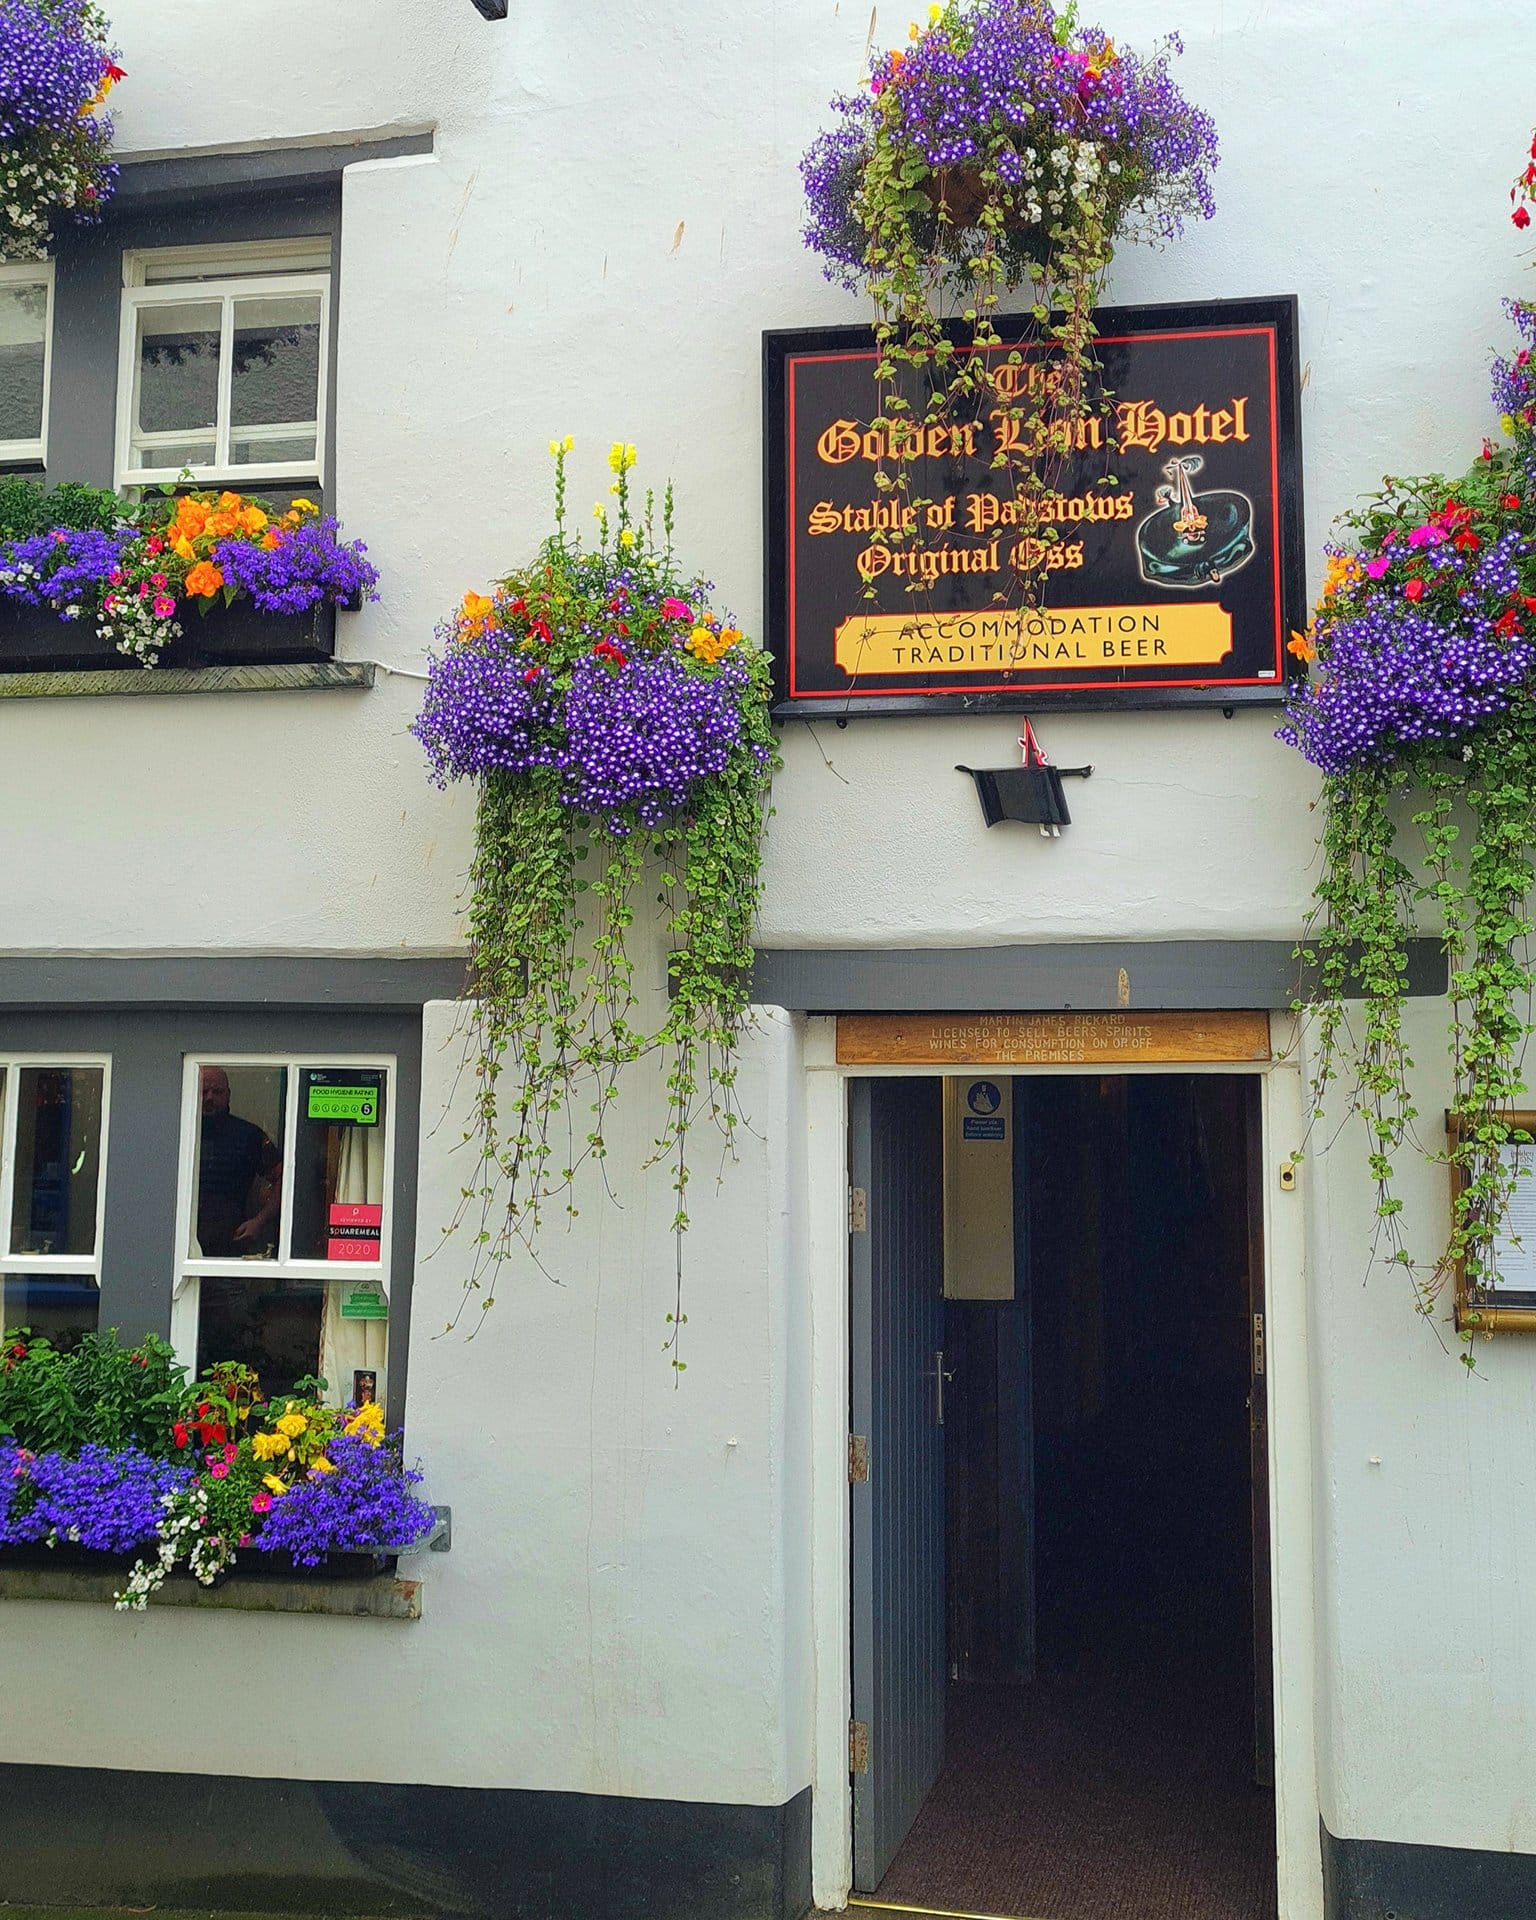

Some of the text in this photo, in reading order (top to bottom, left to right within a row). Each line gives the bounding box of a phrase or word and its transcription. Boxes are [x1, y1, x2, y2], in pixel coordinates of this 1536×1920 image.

[1116, 396, 1250, 454] Hotel
[808, 499, 917, 536] Stable
[925, 494, 955, 531] of
[856, 540, 1001, 582] Original
[898, 614, 1160, 640] ACCOMMODATION
[892, 639, 1168, 665] TRADITIONAL BEER
[980, 1015, 1023, 1026] MARTIN
[1028, 1016, 1066, 1026] JAMES
[932, 1026, 1152, 1039] LICENSED TO SELL BEERS SPIRITS
[929, 1039, 967, 1050] WINES
[975, 1038, 998, 1049] FOR
[1003, 1038, 1085, 1049] CONSUMPTION
[1092, 1037, 1108, 1048] ON
[1131, 1038, 1153, 1048] OFF
[995, 1049, 1085, 1061] THE PREMISES
[330, 1227, 380, 1236] SQUAREMEAL
[339, 1243, 371, 1255] 2020
